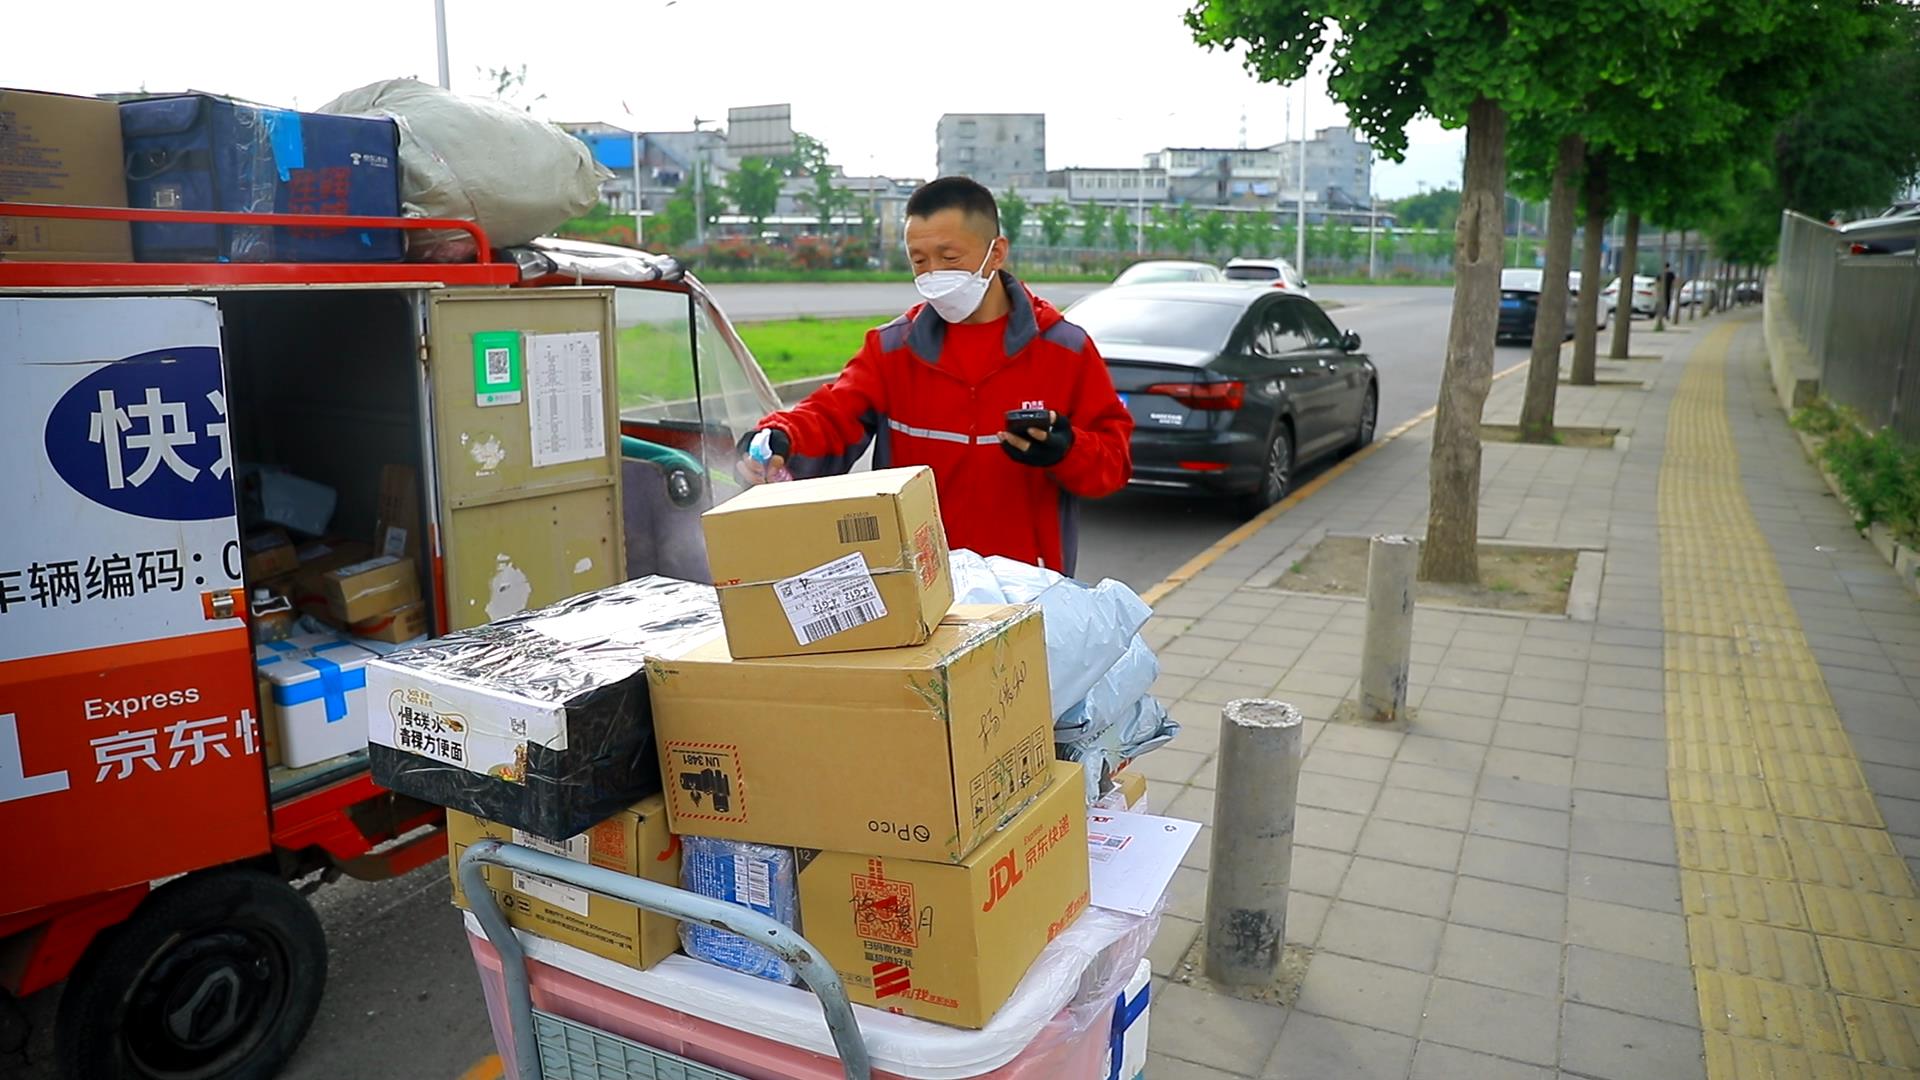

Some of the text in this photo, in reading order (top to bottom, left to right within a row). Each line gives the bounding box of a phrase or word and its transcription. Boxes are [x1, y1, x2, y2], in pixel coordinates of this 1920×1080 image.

[84, 687, 200, 720] Express
[0, 712, 71, 803] L
[399, 727, 463, 762] 青稞方便面
[682, 754, 720, 768] UN 3481
[1024, 814, 1071, 873] 京东快递
[982, 848, 1024, 913] JDL
